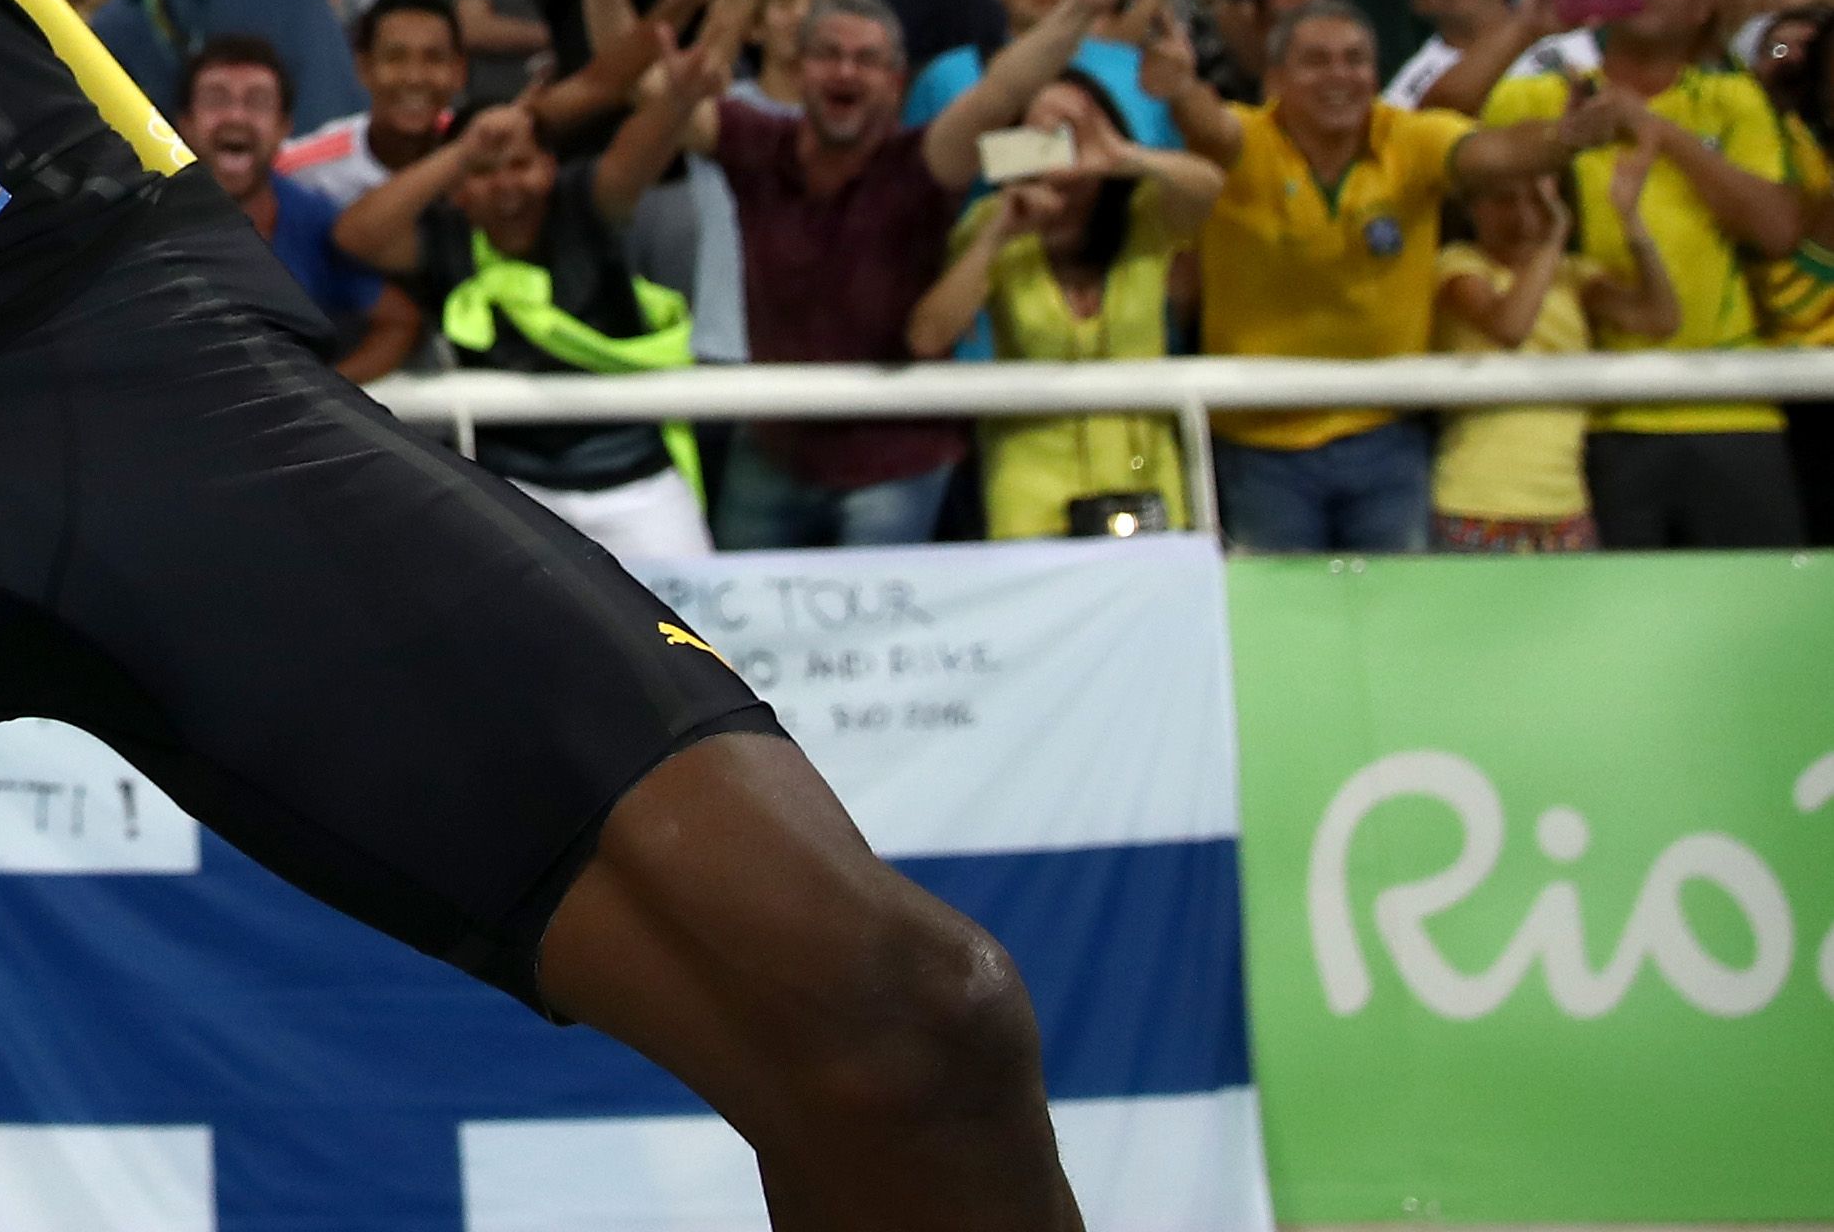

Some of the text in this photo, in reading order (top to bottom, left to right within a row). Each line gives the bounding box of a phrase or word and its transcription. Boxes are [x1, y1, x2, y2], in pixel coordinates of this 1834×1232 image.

[652, 576, 935, 632] PIC TOUR
[1308, 748, 1834, 1021] Rio
